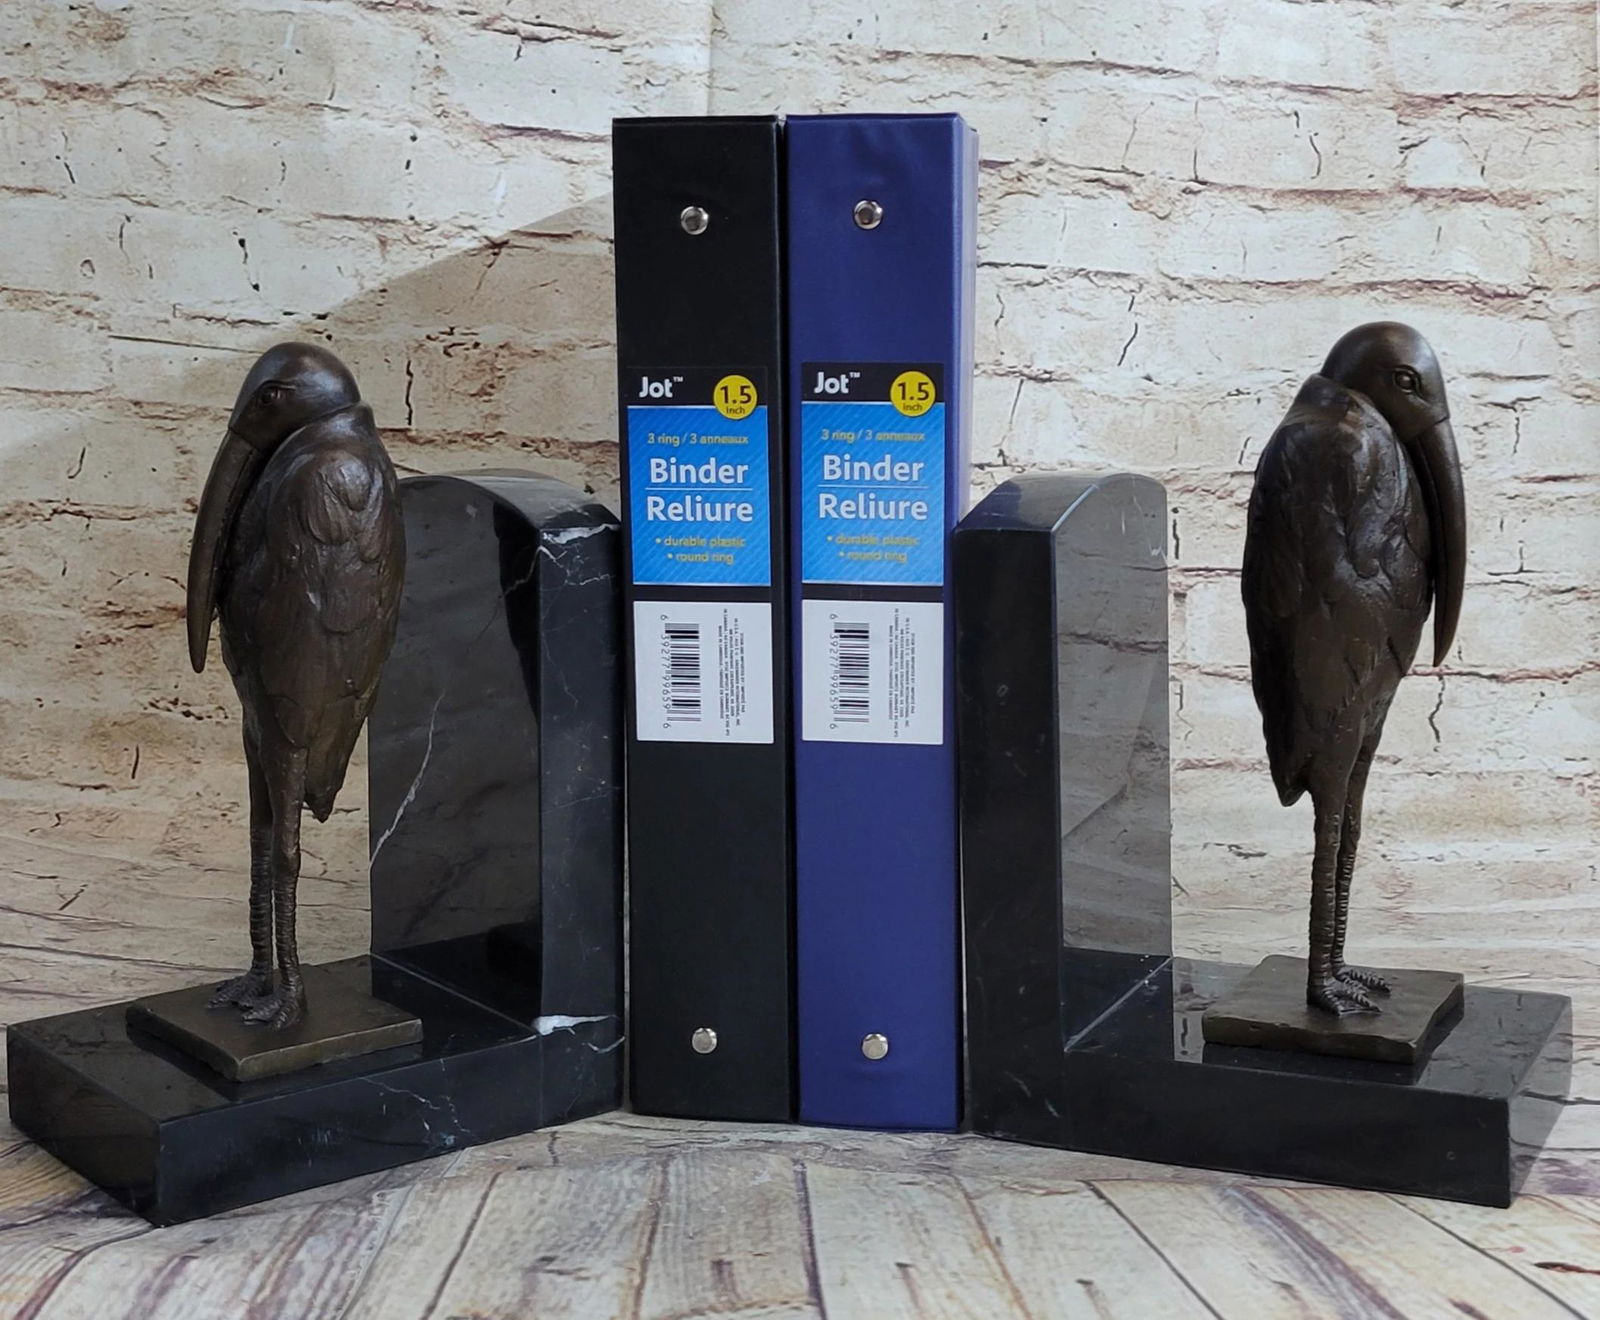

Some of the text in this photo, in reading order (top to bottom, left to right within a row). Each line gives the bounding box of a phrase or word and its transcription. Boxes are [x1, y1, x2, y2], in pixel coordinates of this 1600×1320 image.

[720, 385, 752, 405] 1.5
[898, 382, 930, 402] 1.5
[647, 432, 656, 444] 3
[658, 432, 681, 446] ring
[690, 433, 697, 444] 3
[821, 429, 829, 441] 3
[832, 430, 855, 443] ring
[865, 430, 873, 441] 3
[650, 457, 749, 484] Binder
[823, 454, 924, 481] Binder
[647, 495, 753, 522] Reliure
[818, 493, 928, 520] Reliure
[664, 535, 746, 549] durable plastic
[675, 552, 734, 565] round ring
